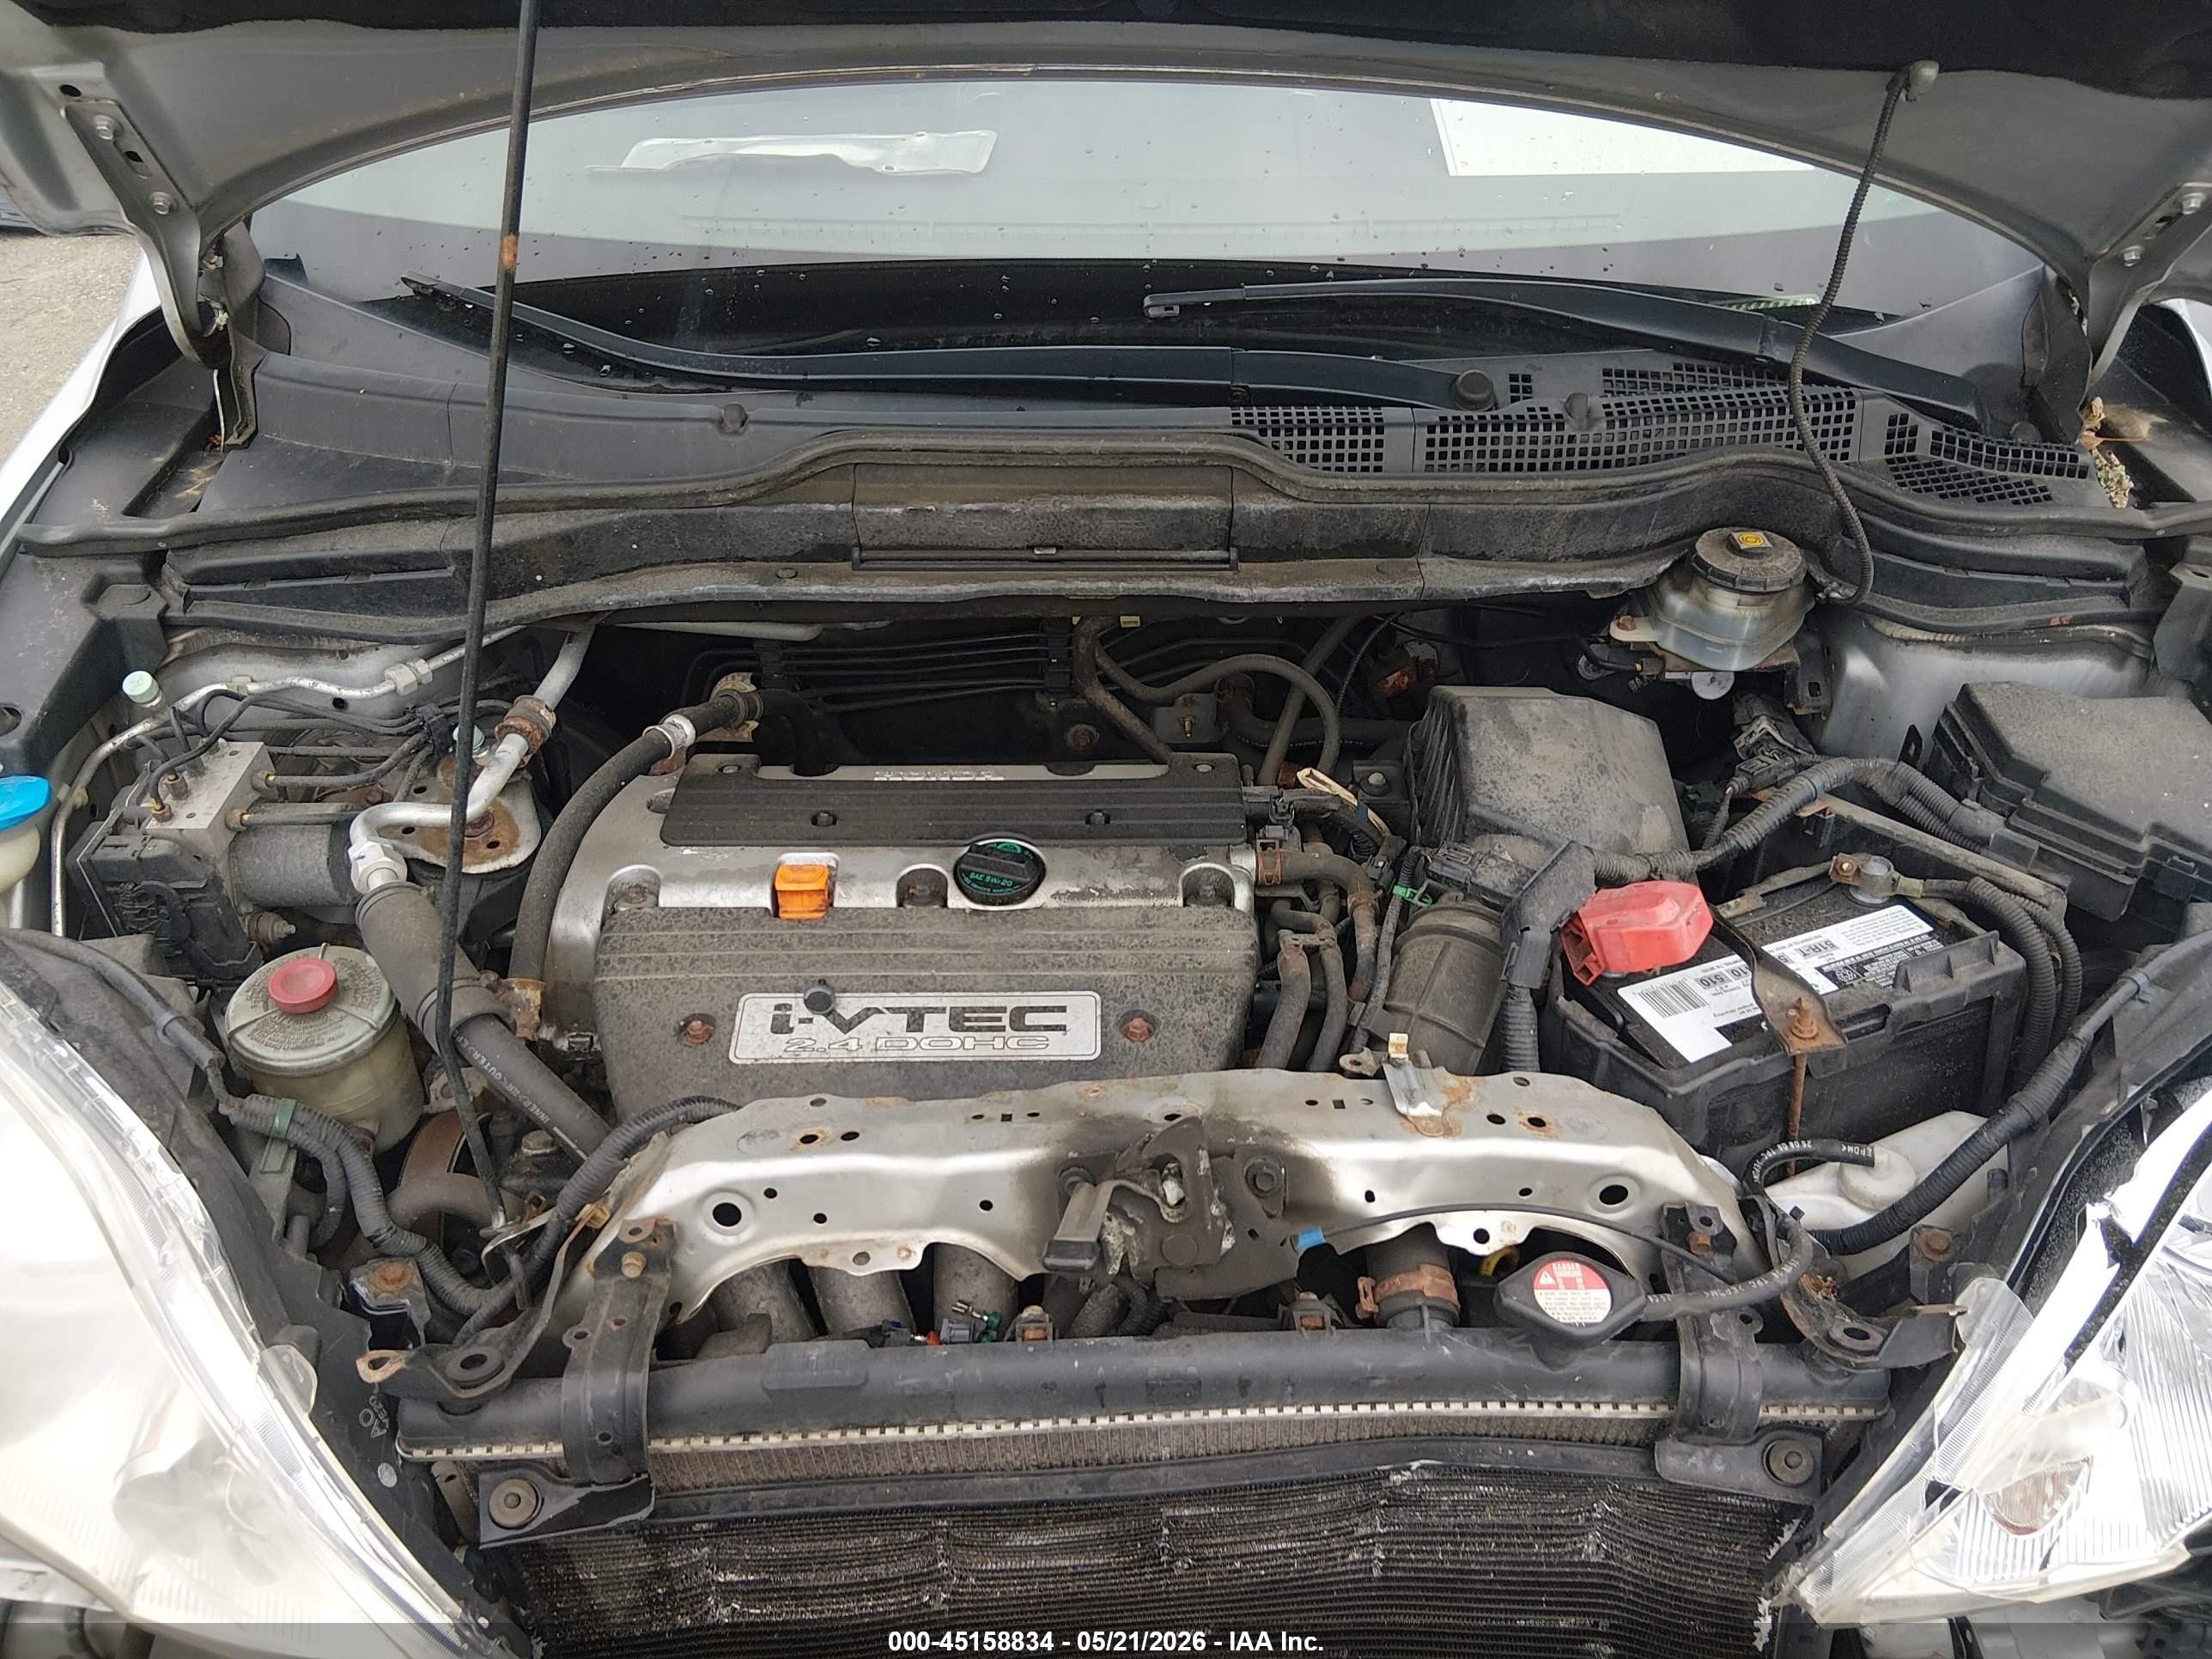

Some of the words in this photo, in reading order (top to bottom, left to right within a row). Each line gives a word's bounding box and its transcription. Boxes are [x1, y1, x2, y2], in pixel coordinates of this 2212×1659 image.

[1699, 974, 1724, 988] 510
[769, 1003, 1067, 1036] i-VTEC
[784, 1036, 863, 1053] 2.4
[875, 1035, 1050, 1052] DOHC
